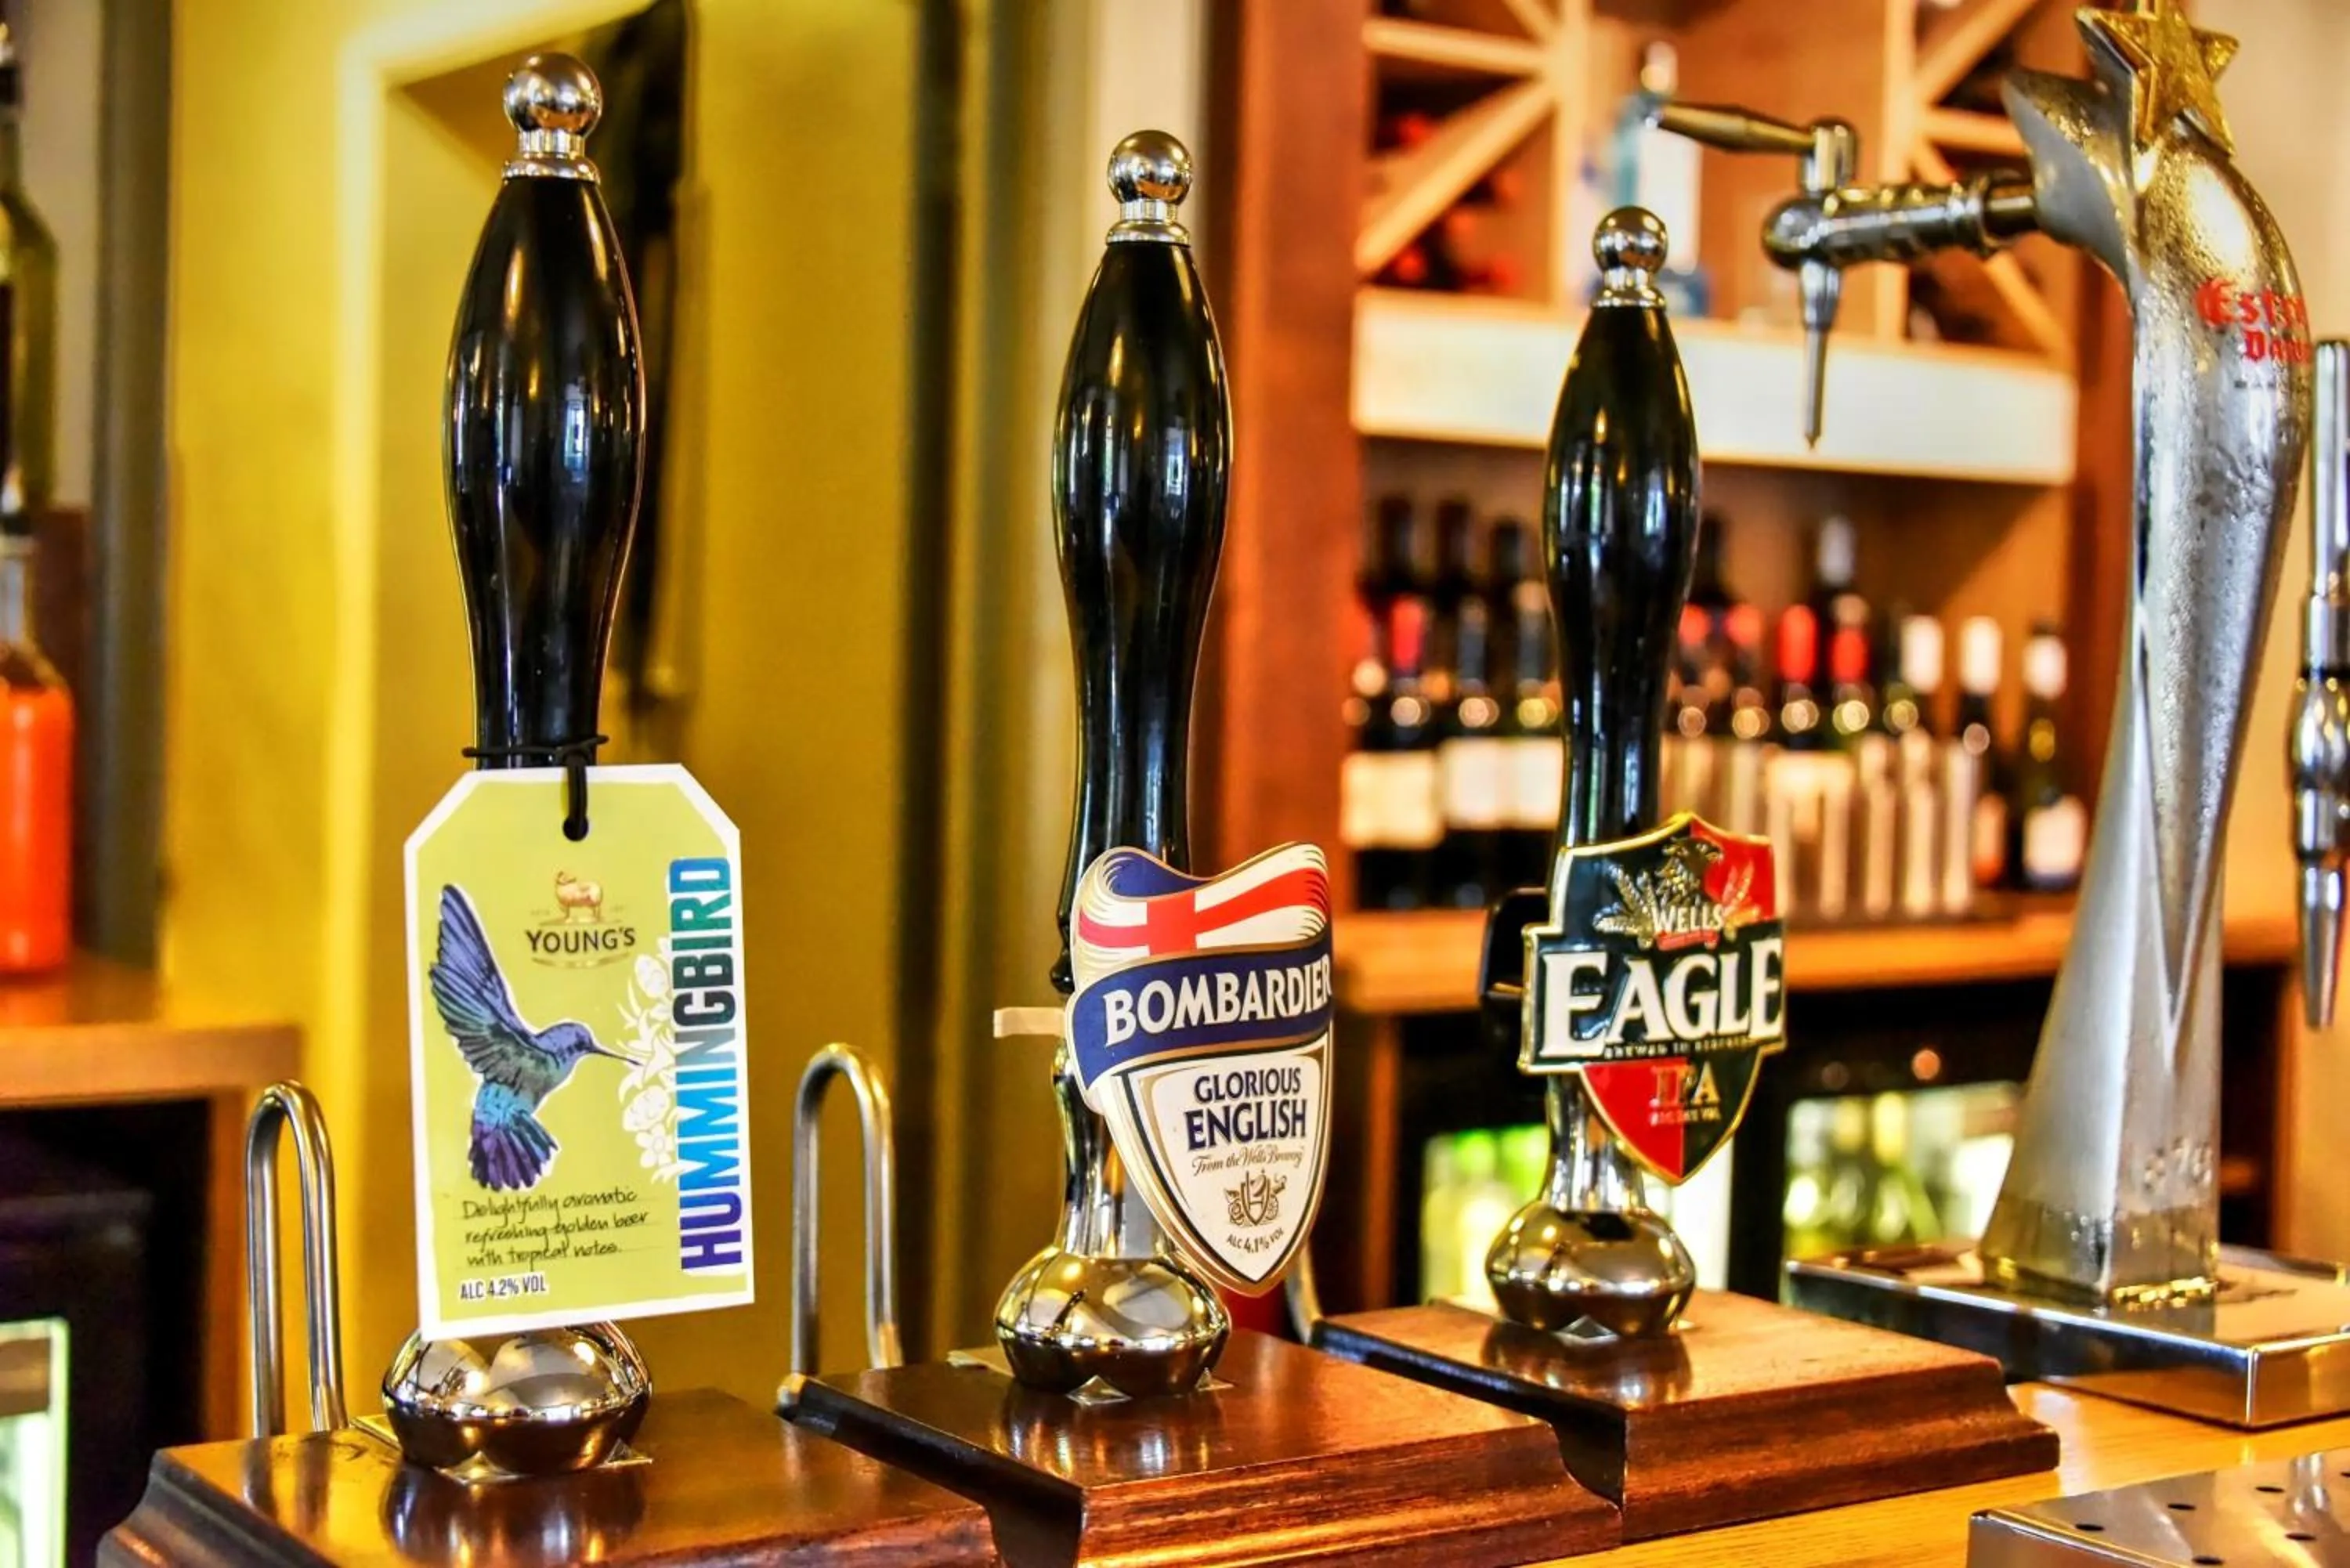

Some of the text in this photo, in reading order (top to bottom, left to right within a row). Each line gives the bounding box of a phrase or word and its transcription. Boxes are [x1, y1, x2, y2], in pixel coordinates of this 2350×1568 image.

[1650, 904, 1723, 932] WELLS
[525, 927, 636, 953] YOUNG'S
[1103, 953, 1332, 1047] BOMBARDIER
[1541, 941, 1782, 1057] EAGLE
[668, 857, 743, 1270] HUMMINGBIRD
[1195, 1068, 1301, 1104] GLORIOUS
[1185, 1099, 1307, 1151] ENGLISH
[1192, 1154, 1223, 1176] From
[1227, 1153, 1240, 1167] the
[462, 1186, 637, 1228] Delightfully aromatic
[465, 1211, 649, 1253] refreshing golden beer
[1227, 1234, 1242, 1248] ALC
[1244, 1236, 1269, 1253] 4.1%
[467, 1251, 503, 1266] with
[509, 1241, 569, 1271] tropical
[460, 1274, 546, 1299] ALC 4.2% VOL
